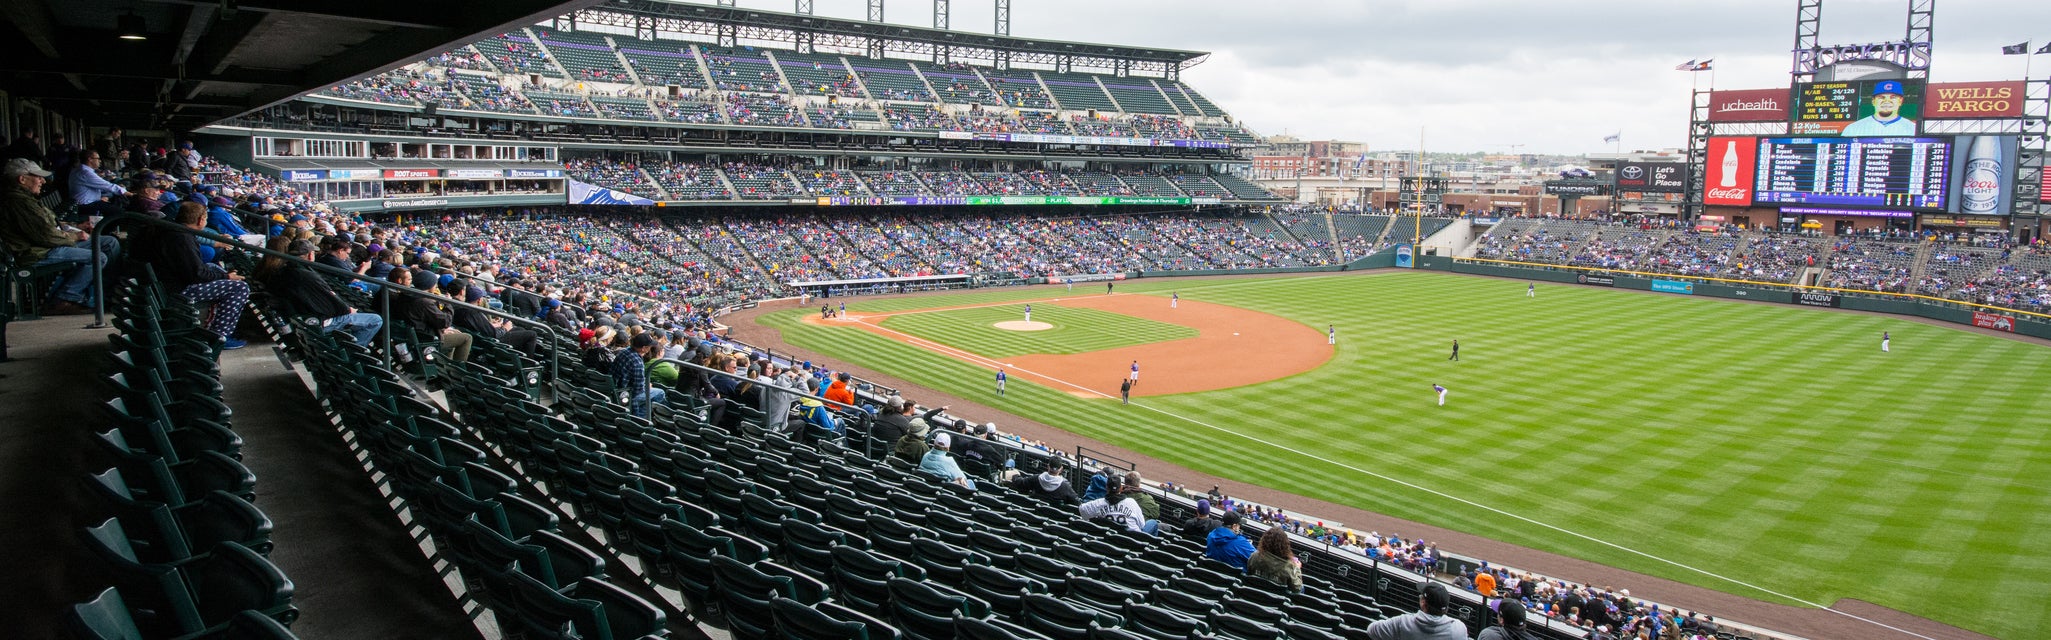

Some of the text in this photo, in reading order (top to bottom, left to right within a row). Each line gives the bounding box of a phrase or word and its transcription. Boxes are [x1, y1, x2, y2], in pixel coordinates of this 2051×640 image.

[1789, 41, 1932, 74] ROCKIES
[1937, 88, 2011, 100] WELLS
[1722, 98, 1777, 111] uchealth
[1937, 100, 2010, 112] FARGO
[1793, 122, 1803, 130] 12
[1963, 178, 1997, 188] Coors
[1548, 186, 1594, 194] TUNDRA
[1708, 188, 1746, 200] Coca-Cola
[1975, 312, 1998, 321] brakes
[1977, 319, 1992, 327] plus
[1100, 504, 1132, 518] ARENADO
